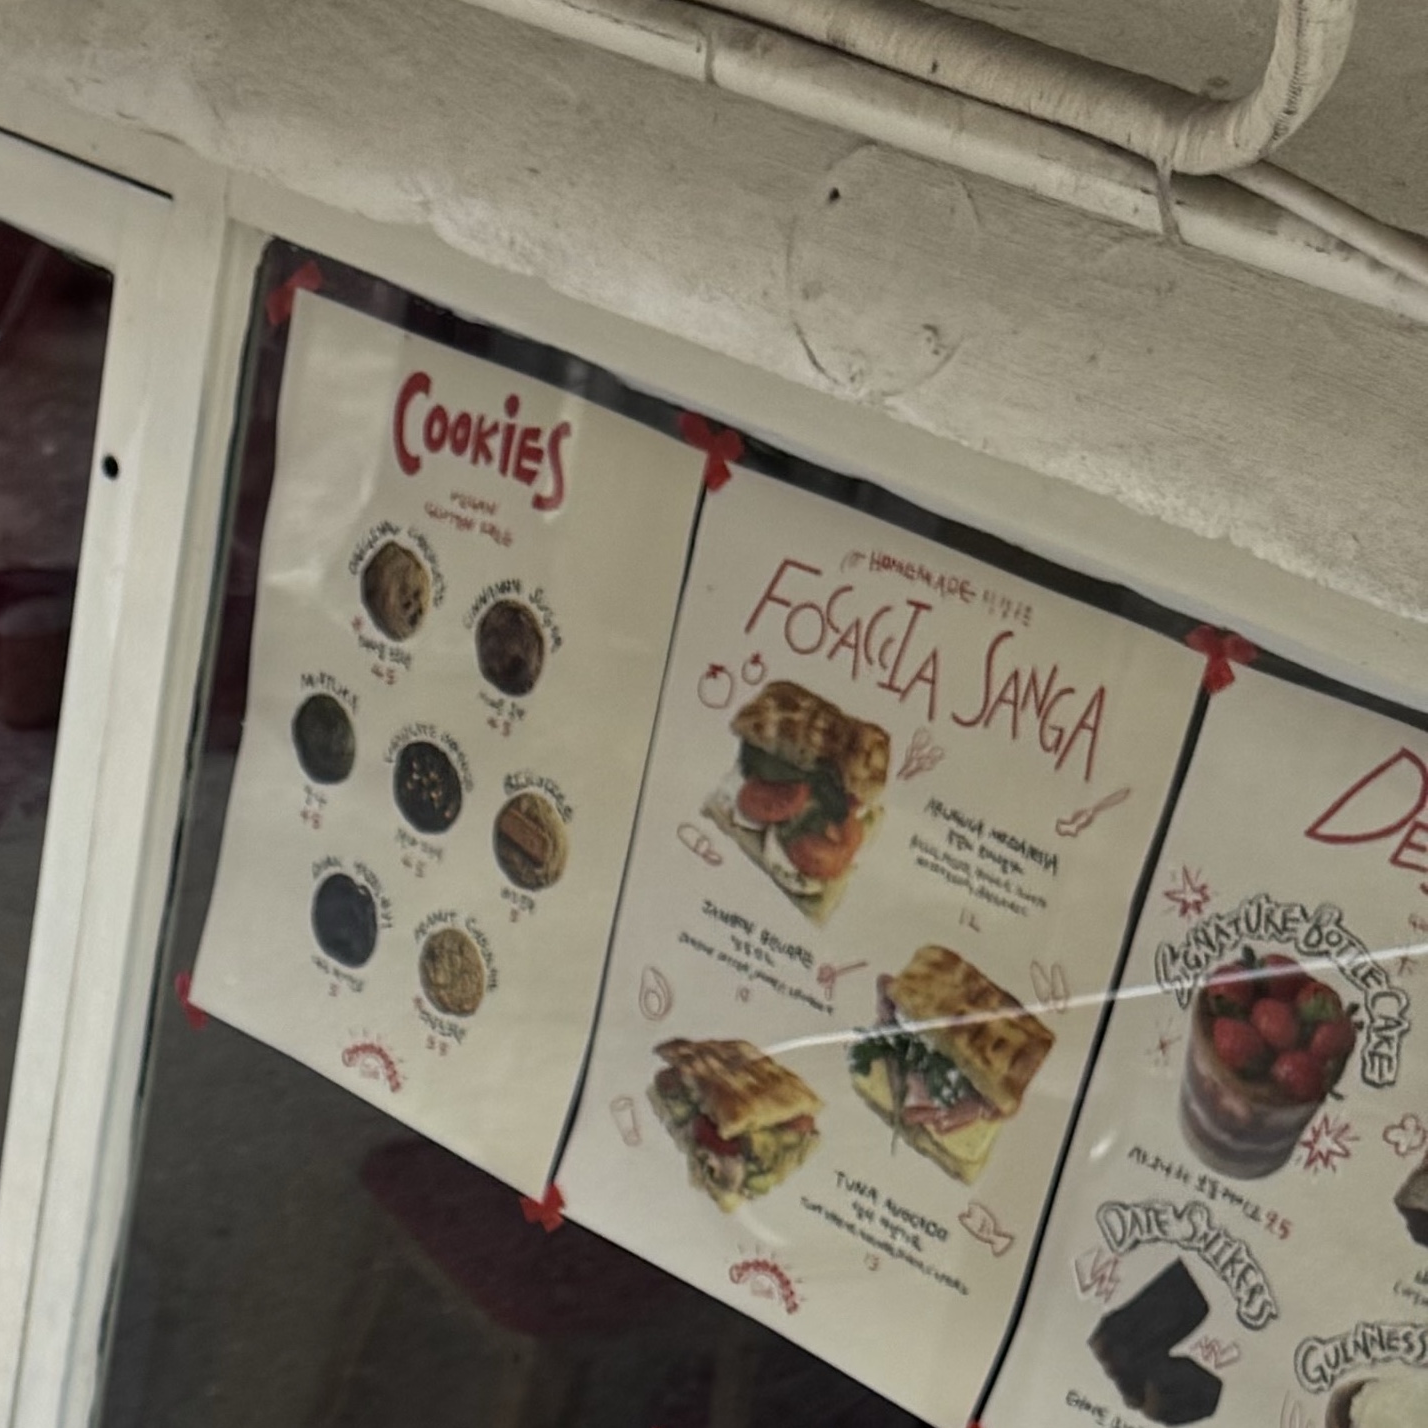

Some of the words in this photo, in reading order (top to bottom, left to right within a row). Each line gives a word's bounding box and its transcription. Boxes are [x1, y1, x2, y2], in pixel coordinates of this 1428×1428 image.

[393, 371, 572, 511] COOKIES
[951, 630, 1107, 783] SANGA
[1156, 895, 1297, 1006] SIGNATURE
[1363, 986, 1408, 1087] CAKE
[835, 1169, 879, 1203] TUNA
[885, 1198, 949, 1242] AVOCADO
[1099, 1202, 1170, 1251] DATE
